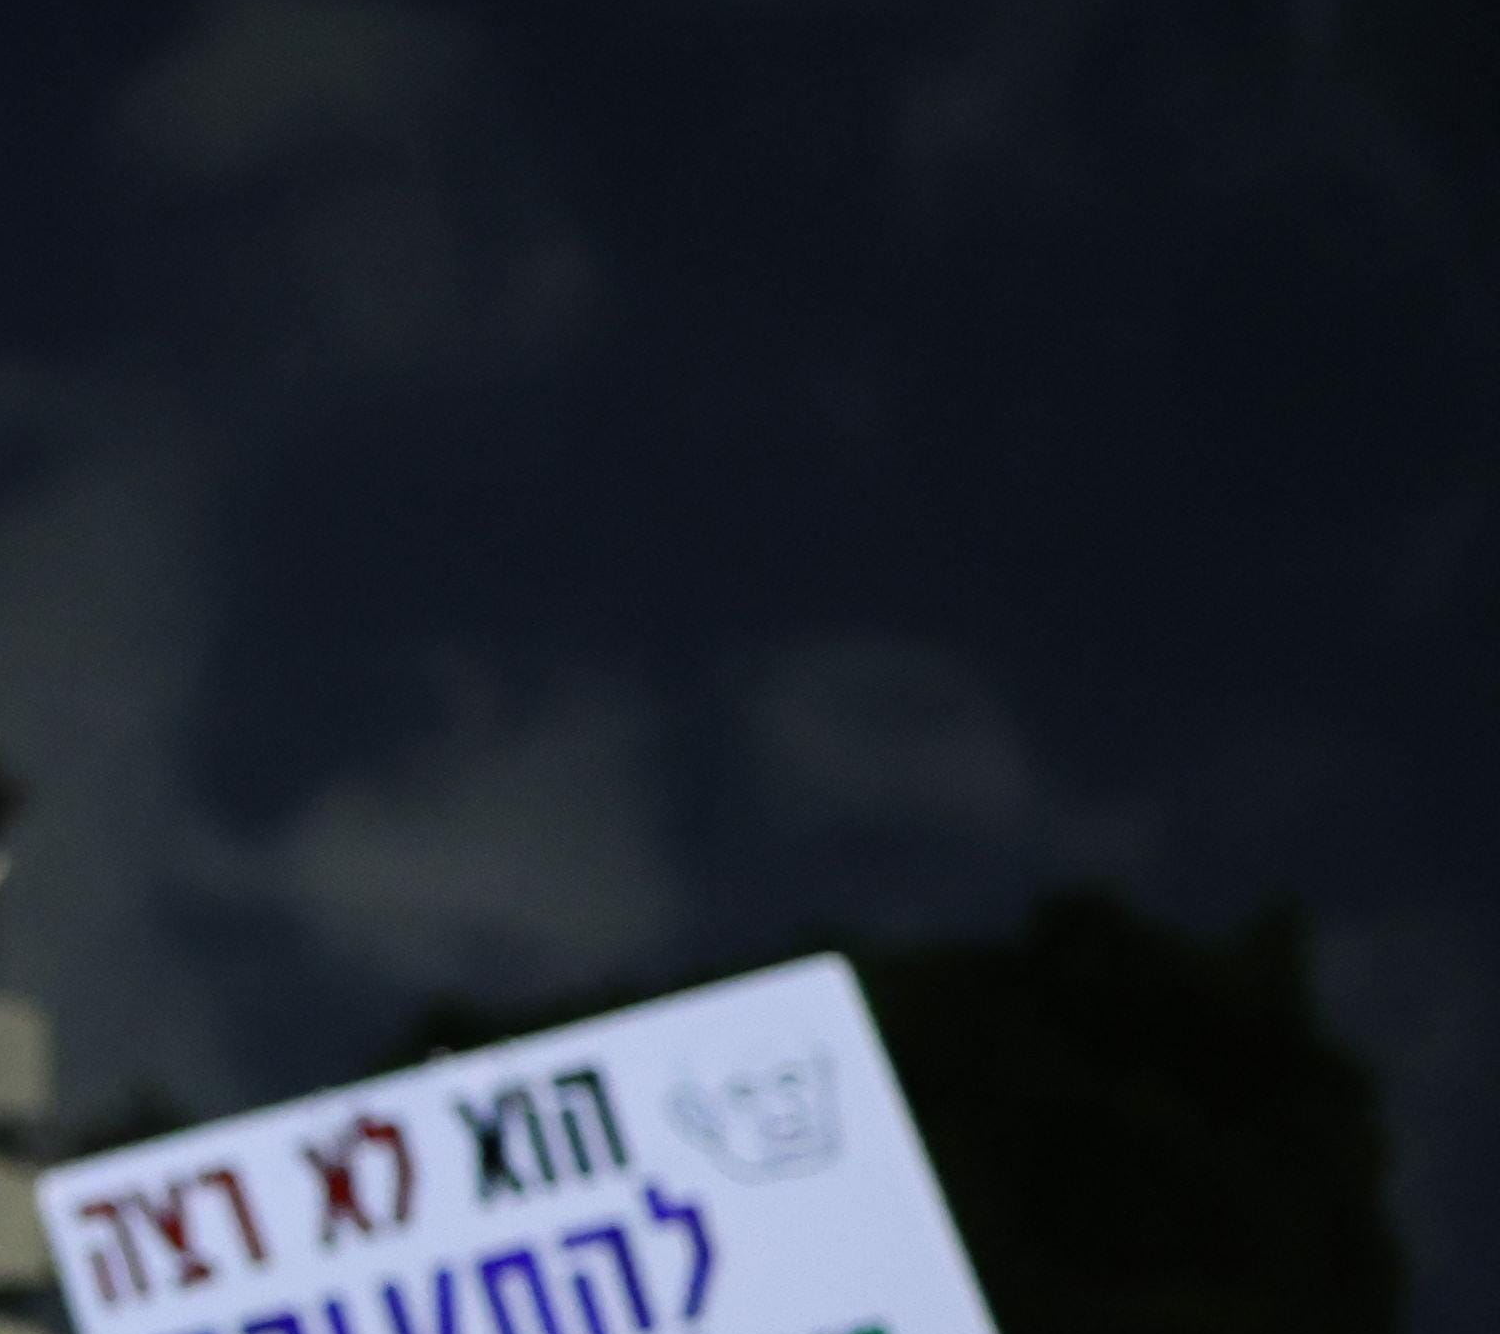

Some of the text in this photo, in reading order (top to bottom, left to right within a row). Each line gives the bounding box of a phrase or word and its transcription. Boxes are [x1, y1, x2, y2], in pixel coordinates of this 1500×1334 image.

[77, 1069, 629, 1303] הוא לא רצה
